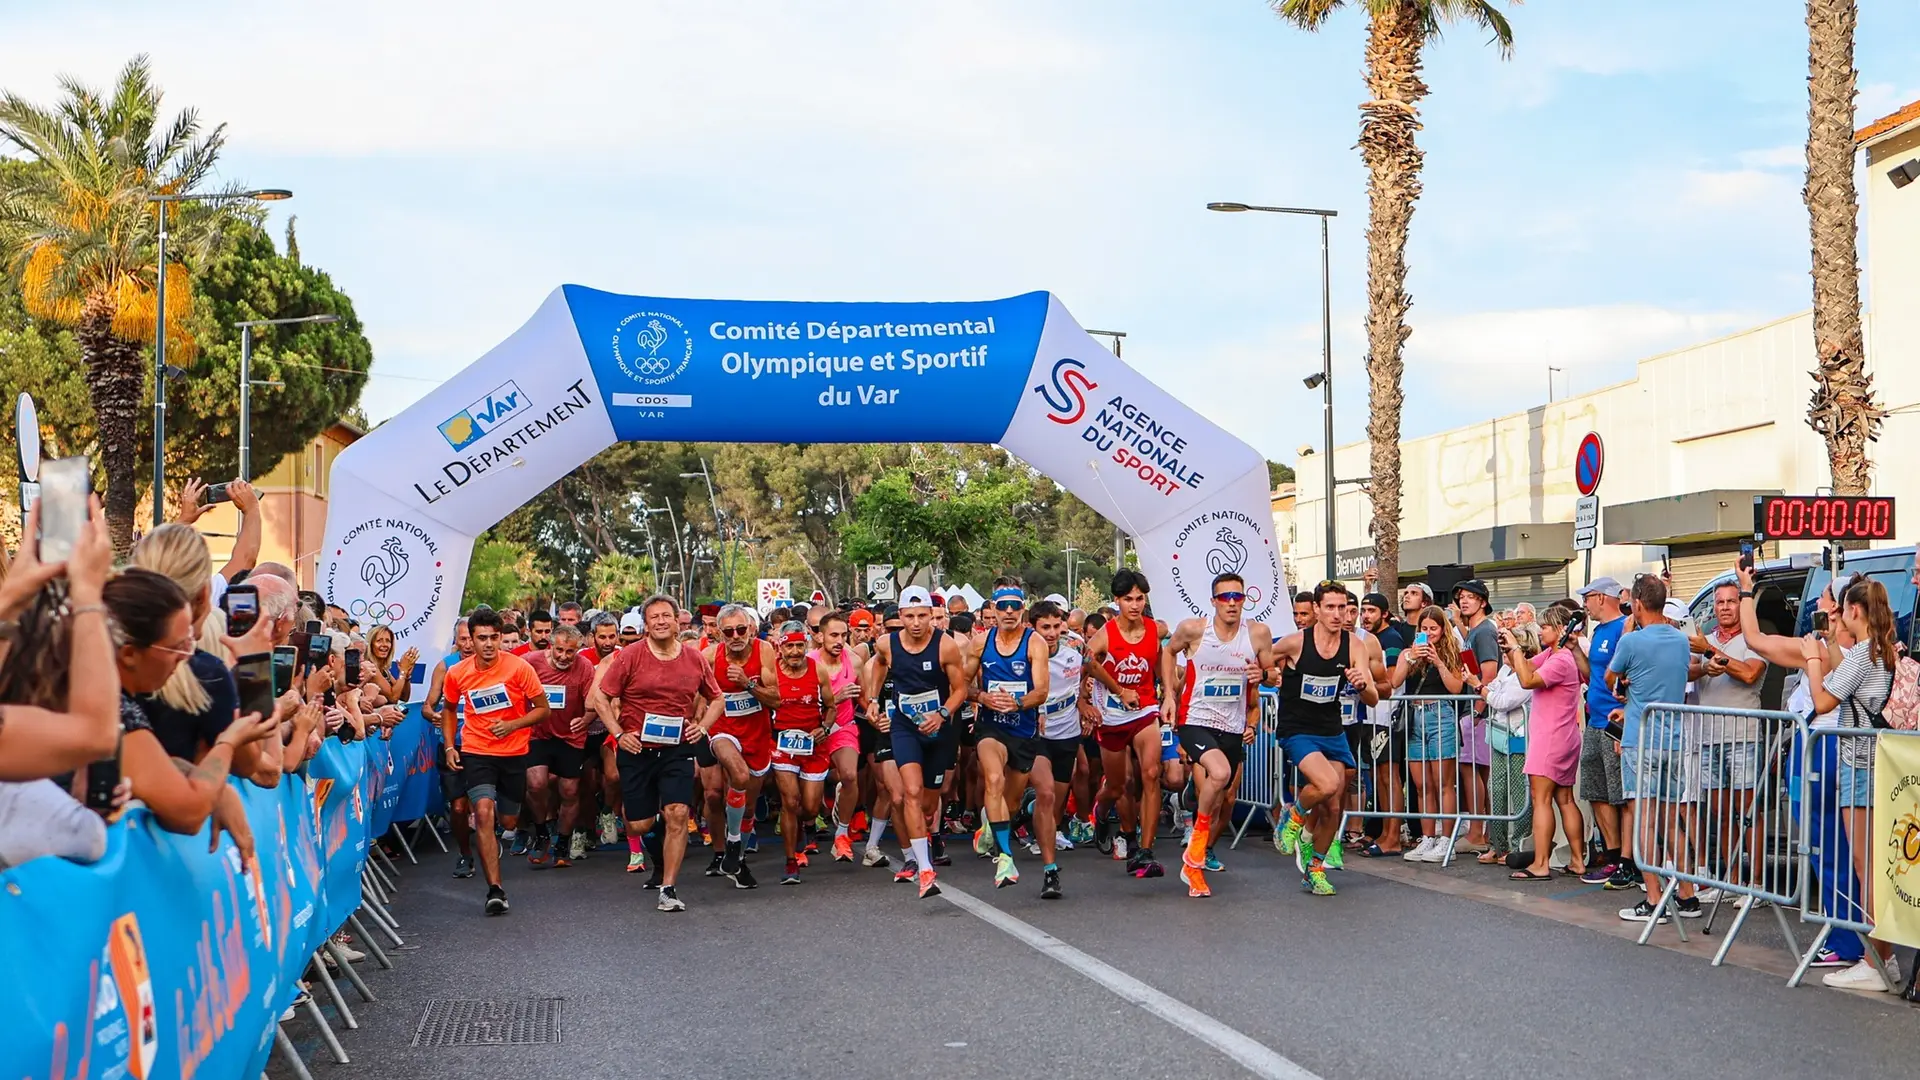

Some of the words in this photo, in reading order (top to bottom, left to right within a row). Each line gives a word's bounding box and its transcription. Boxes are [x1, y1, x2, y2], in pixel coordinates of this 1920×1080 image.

[648, 311, 684, 328] NATIONAL
[709, 321, 800, 340] Comité
[807, 317, 996, 344] Départemental
[612, 335, 634, 378] OLYMPIQUE
[633, 374, 644, 383] ET
[645, 373, 676, 385] SPORTIF
[721, 351, 864, 380] Olympique
[870, 353, 895, 372] et
[901, 345, 988, 375] Sportif
[636, 396, 669, 405] CDOS
[818, 385, 851, 407] du
[857, 385, 900, 405] Var
[442, 378, 592, 488] DÉPARTEMENT
[1107, 395, 1188, 455] AGENCE
[1095, 408, 1205, 489] NATIONALE
[1081, 425, 1114, 452] DU
[1111, 448, 1180, 496] SPORT
[342, 517, 382, 545] COMITÉ
[386, 519, 439, 556] NATIONAL
[1174, 513, 1210, 548] COMITÉ
[1211, 510, 1262, 536] NATIONAL
[326, 562, 337, 605] OLYMP
[875, 582, 886, 590] 30
[1171, 566, 1208, 618] OLYMPIQU
[1252, 606, 1273, 623] RTIF
[1216, 664, 1247, 673] GARONN
[481, 695, 500, 707] 178
[1213, 686, 1232, 696] 714
[1311, 685, 1328, 697] 281
[733, 700, 751, 711] 186
[911, 702, 930, 714] 321
[660, 725, 665, 737] 1
[786, 738, 804, 749] 270
